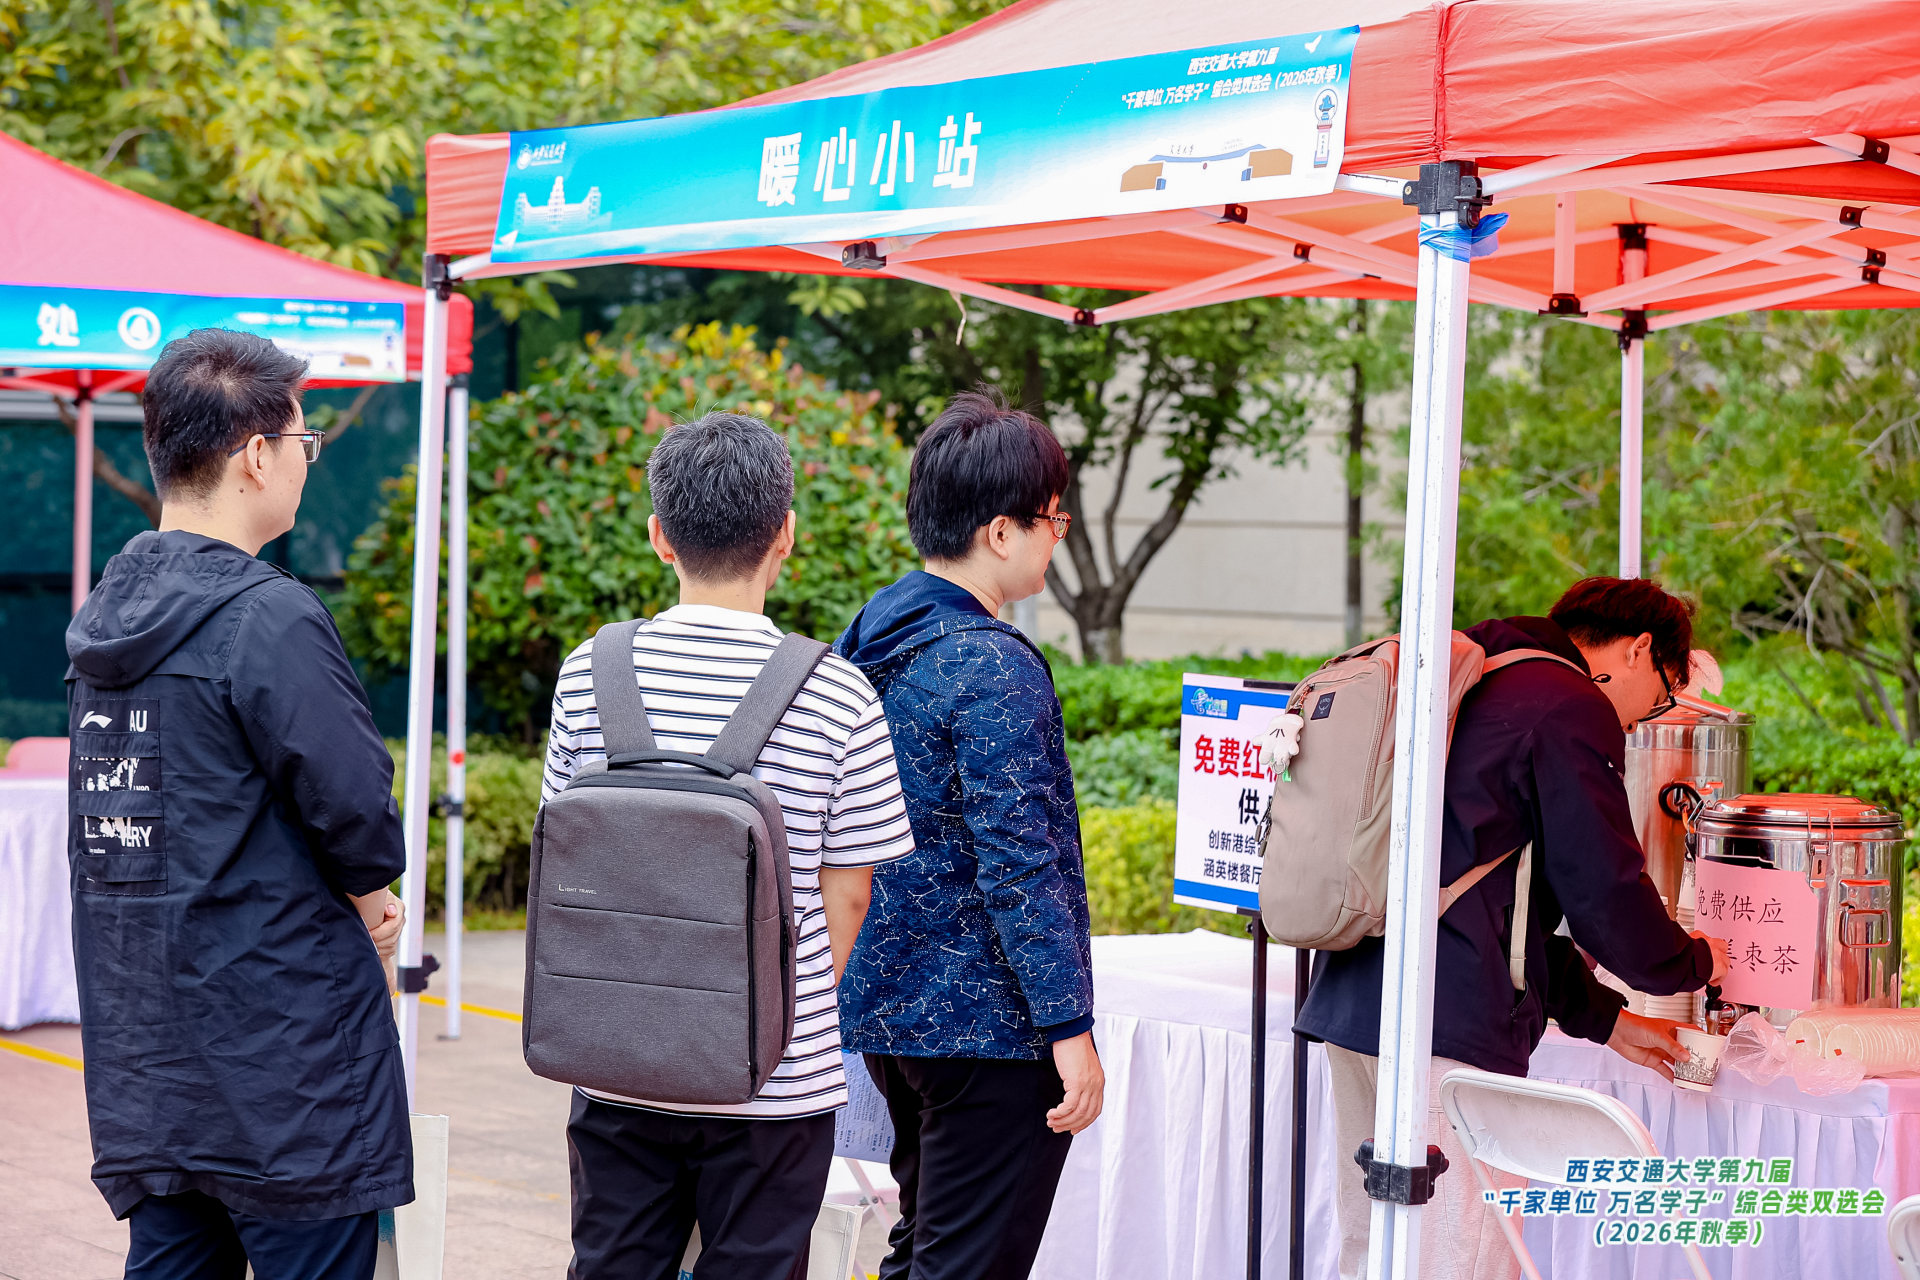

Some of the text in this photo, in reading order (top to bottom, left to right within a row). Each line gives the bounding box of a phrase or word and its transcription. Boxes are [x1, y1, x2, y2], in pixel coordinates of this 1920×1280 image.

[1187, 47, 1280, 75] 西安交通大学第九届
[757, 112, 982, 207] 暖心小站
[1238, 788, 1273, 826] 供
[1697, 886, 1785, 925] 免费供应
